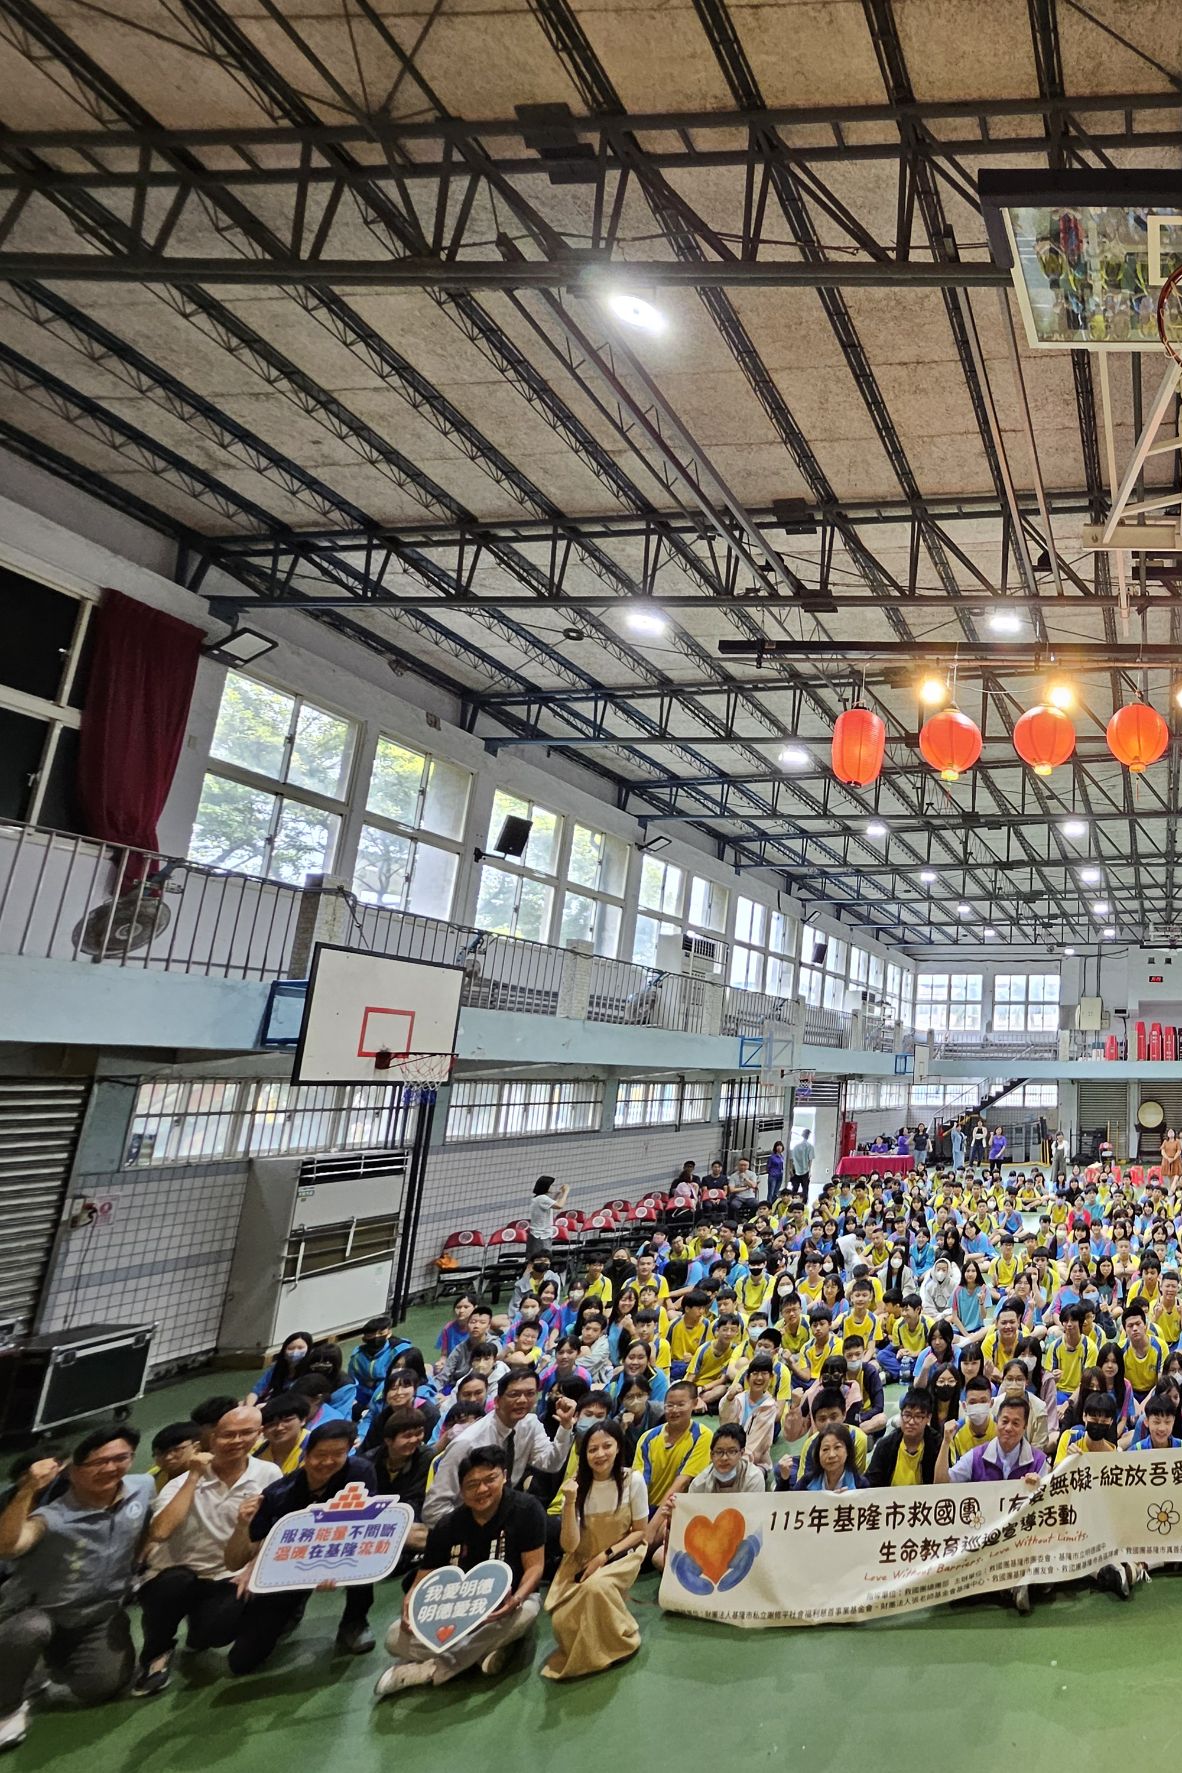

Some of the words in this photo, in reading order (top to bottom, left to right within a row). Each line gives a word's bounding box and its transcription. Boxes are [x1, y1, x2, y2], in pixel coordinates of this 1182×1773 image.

[280, 1522, 398, 1544] 服務能量不間斷
[879, 1504, 1077, 1564] 生命教育巡迴宣導活動
[273, 1540, 391, 1562] 溫暖在基隆流動
[864, 1572, 888, 1582] Love
[1014, 1535, 1053, 1549] Without
[423, 1577, 496, 1603] 我愛明德
[417, 1598, 489, 1624] 明德愛我
